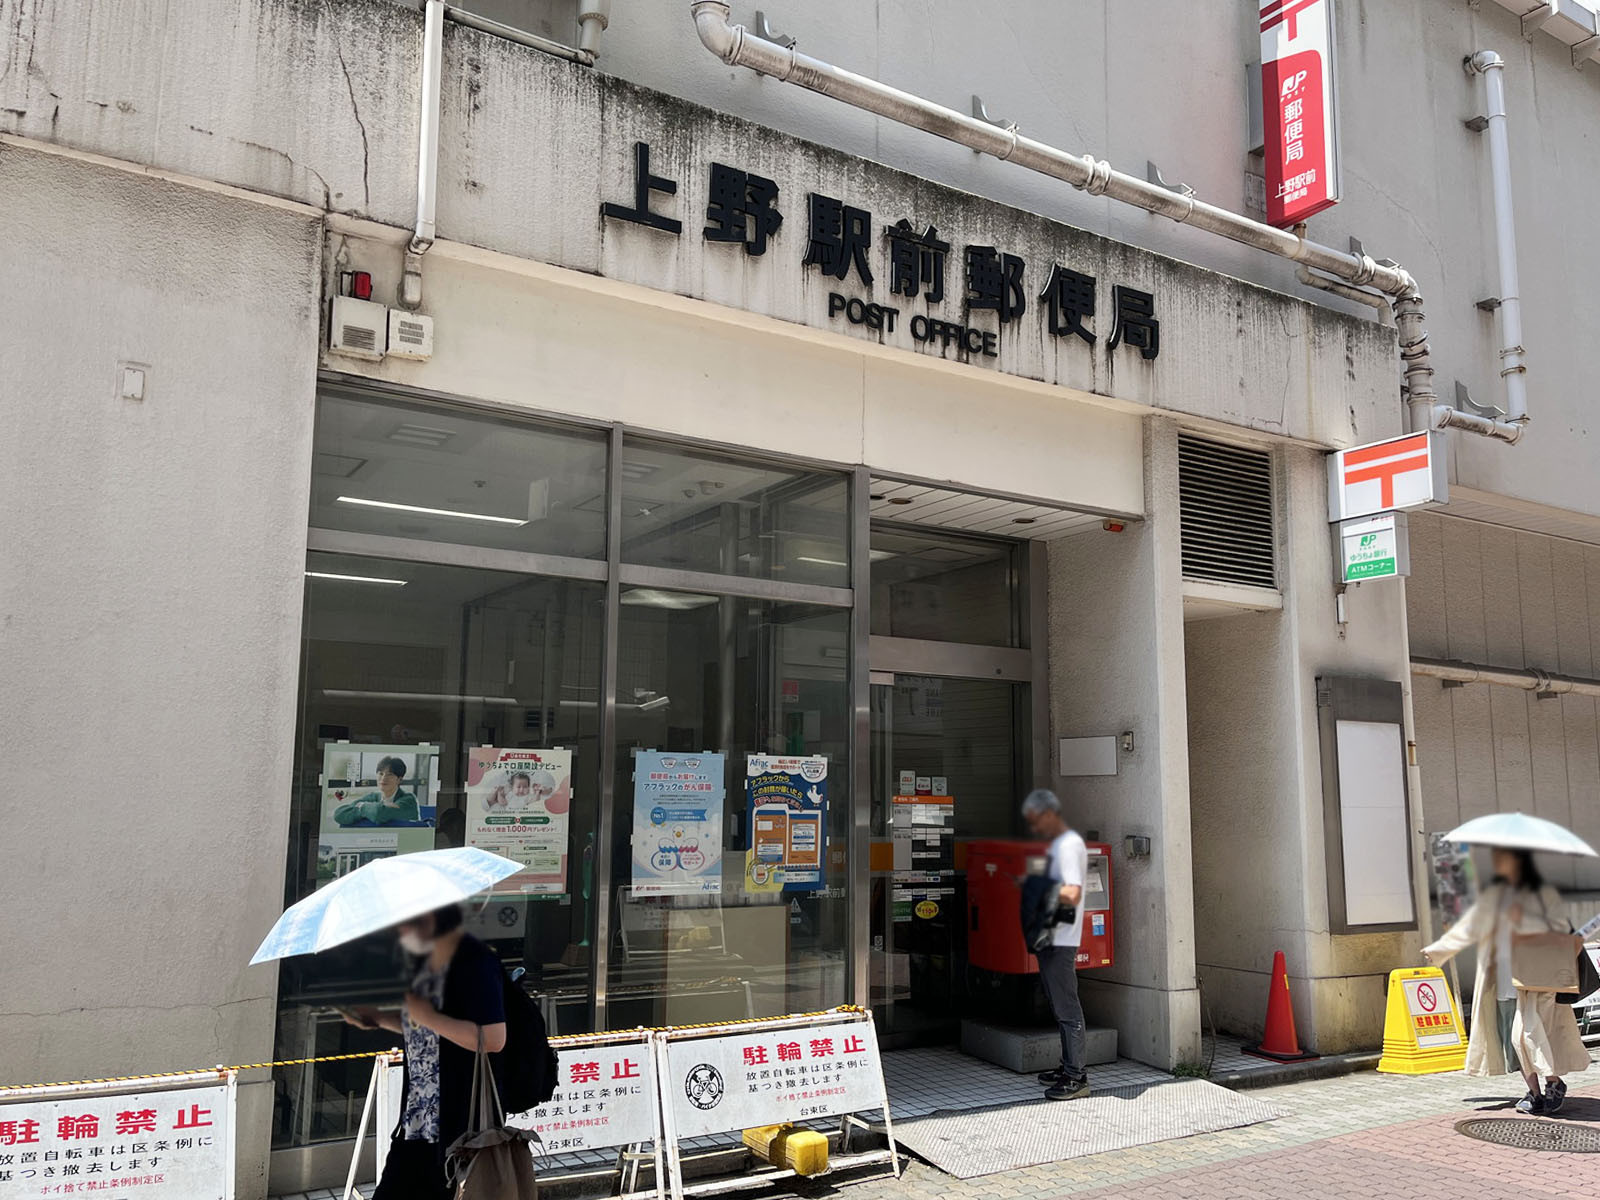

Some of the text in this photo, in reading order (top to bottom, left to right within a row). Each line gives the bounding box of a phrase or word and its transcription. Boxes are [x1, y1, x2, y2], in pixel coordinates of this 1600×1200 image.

[1284, 98, 1303, 165] 郵便局
[1274, 168, 1316, 199] 上野駅前
[600, 141, 1161, 362] 上野駅前郵便局
[828, 293, 998, 358] POST OFFICE
[1352, 562, 1392, 573] ATMコーナー
[742, 1035, 866, 1066] 駐輪禁止
[569, 1058, 640, 1084] 禁止
[746, 1058, 869, 1081] 放置自転車は区条例に
[748, 1073, 843, 1093] 基つき撤去します
[0, 1104, 213, 1145] 駐輪禁止
[799, 1104, 828, 1116] 台東区
[0, 1136, 213, 1166] 放置自転車は区条例に
[548, 1137, 584, 1150] 台東区
